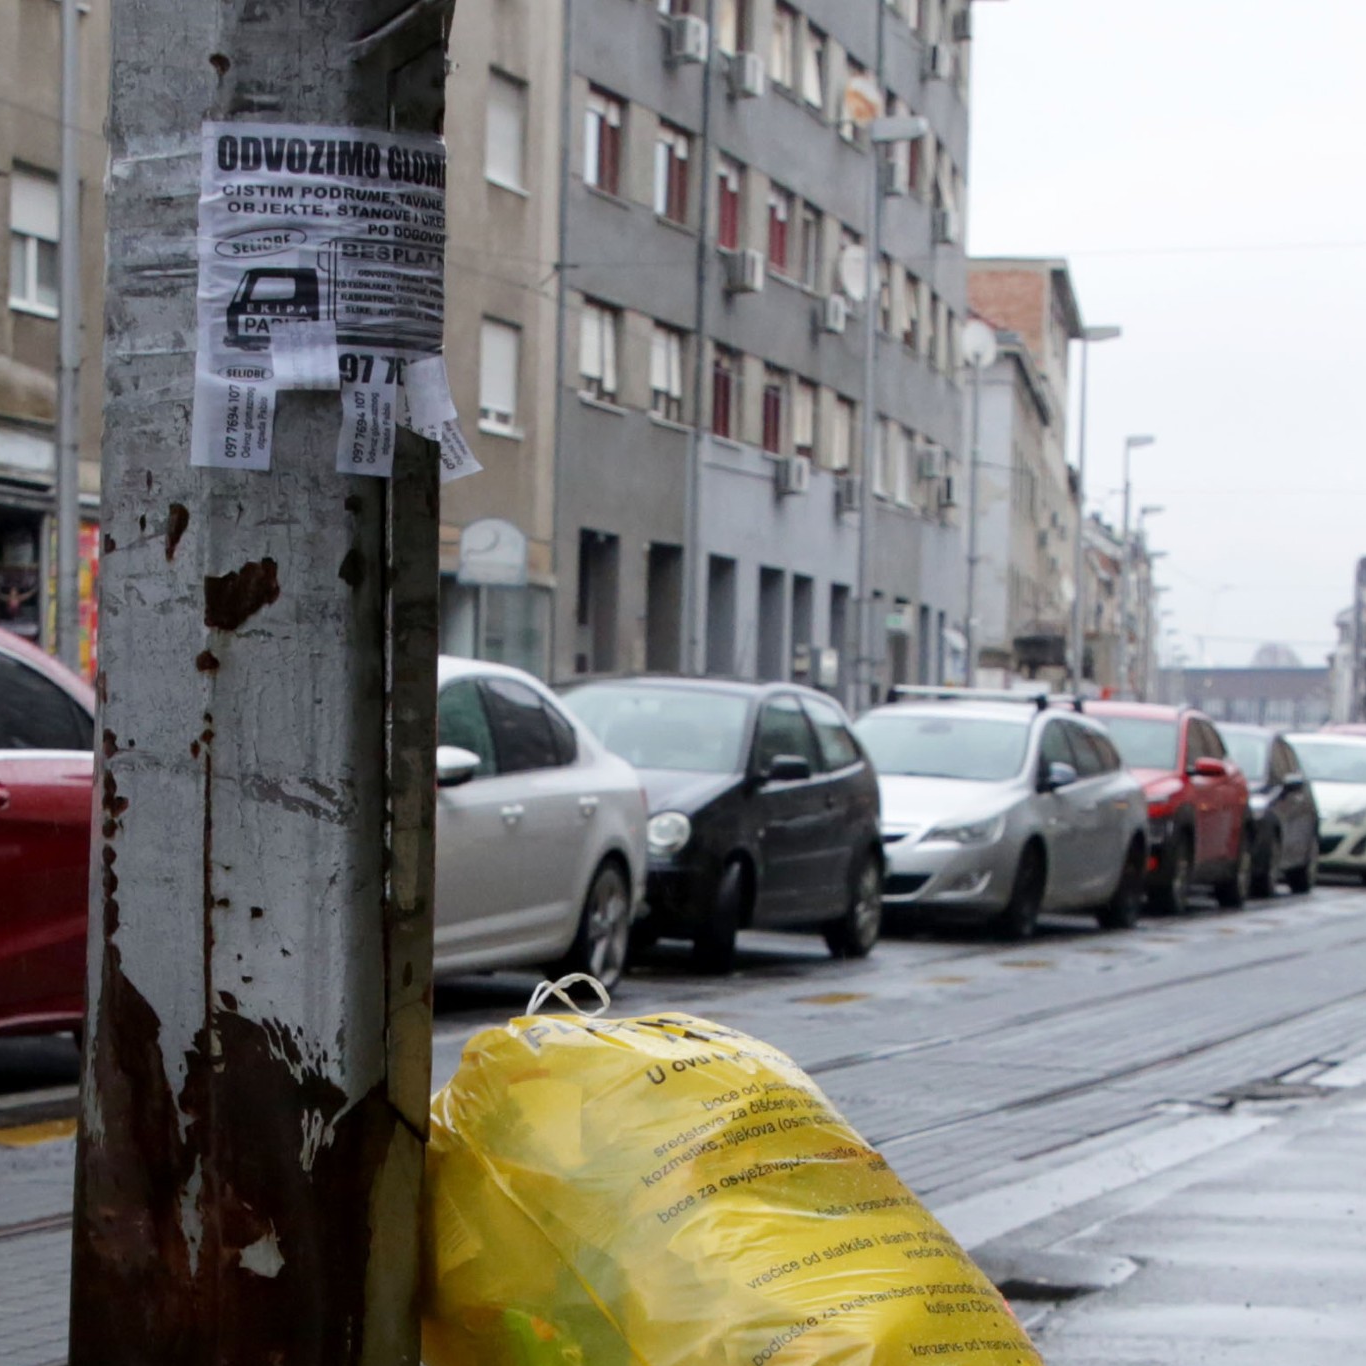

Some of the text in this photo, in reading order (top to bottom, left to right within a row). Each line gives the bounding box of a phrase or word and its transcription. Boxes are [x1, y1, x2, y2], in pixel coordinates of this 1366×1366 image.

[218, 135, 380, 179] ODVOZIMO
[227, 202, 330, 217] OBJEKTE,
[337, 205, 413, 223] STANOVE
[368, 224, 388, 237] PO
[246, 303, 308, 314] EKIPA
[226, 367, 267, 380] SELIDBE
[229, 385, 241, 404] 107
[356, 391, 366, 409] 107
[646, 1067, 666, 1086] U
[671, 1054, 711, 1074] ovu
[701, 1082, 759, 1111] boce od
[653, 1114, 727, 1159] sredstava
[730, 1105, 748, 1123] za
[641, 1138, 725, 1188] kozmetike,
[724, 1120, 777, 1148] lijekova
[656, 1193, 696, 1225] boce
[697, 1182, 718, 1197] za
[802, 1251, 823, 1267] od
[825, 1238, 873, 1261] slatkiša
